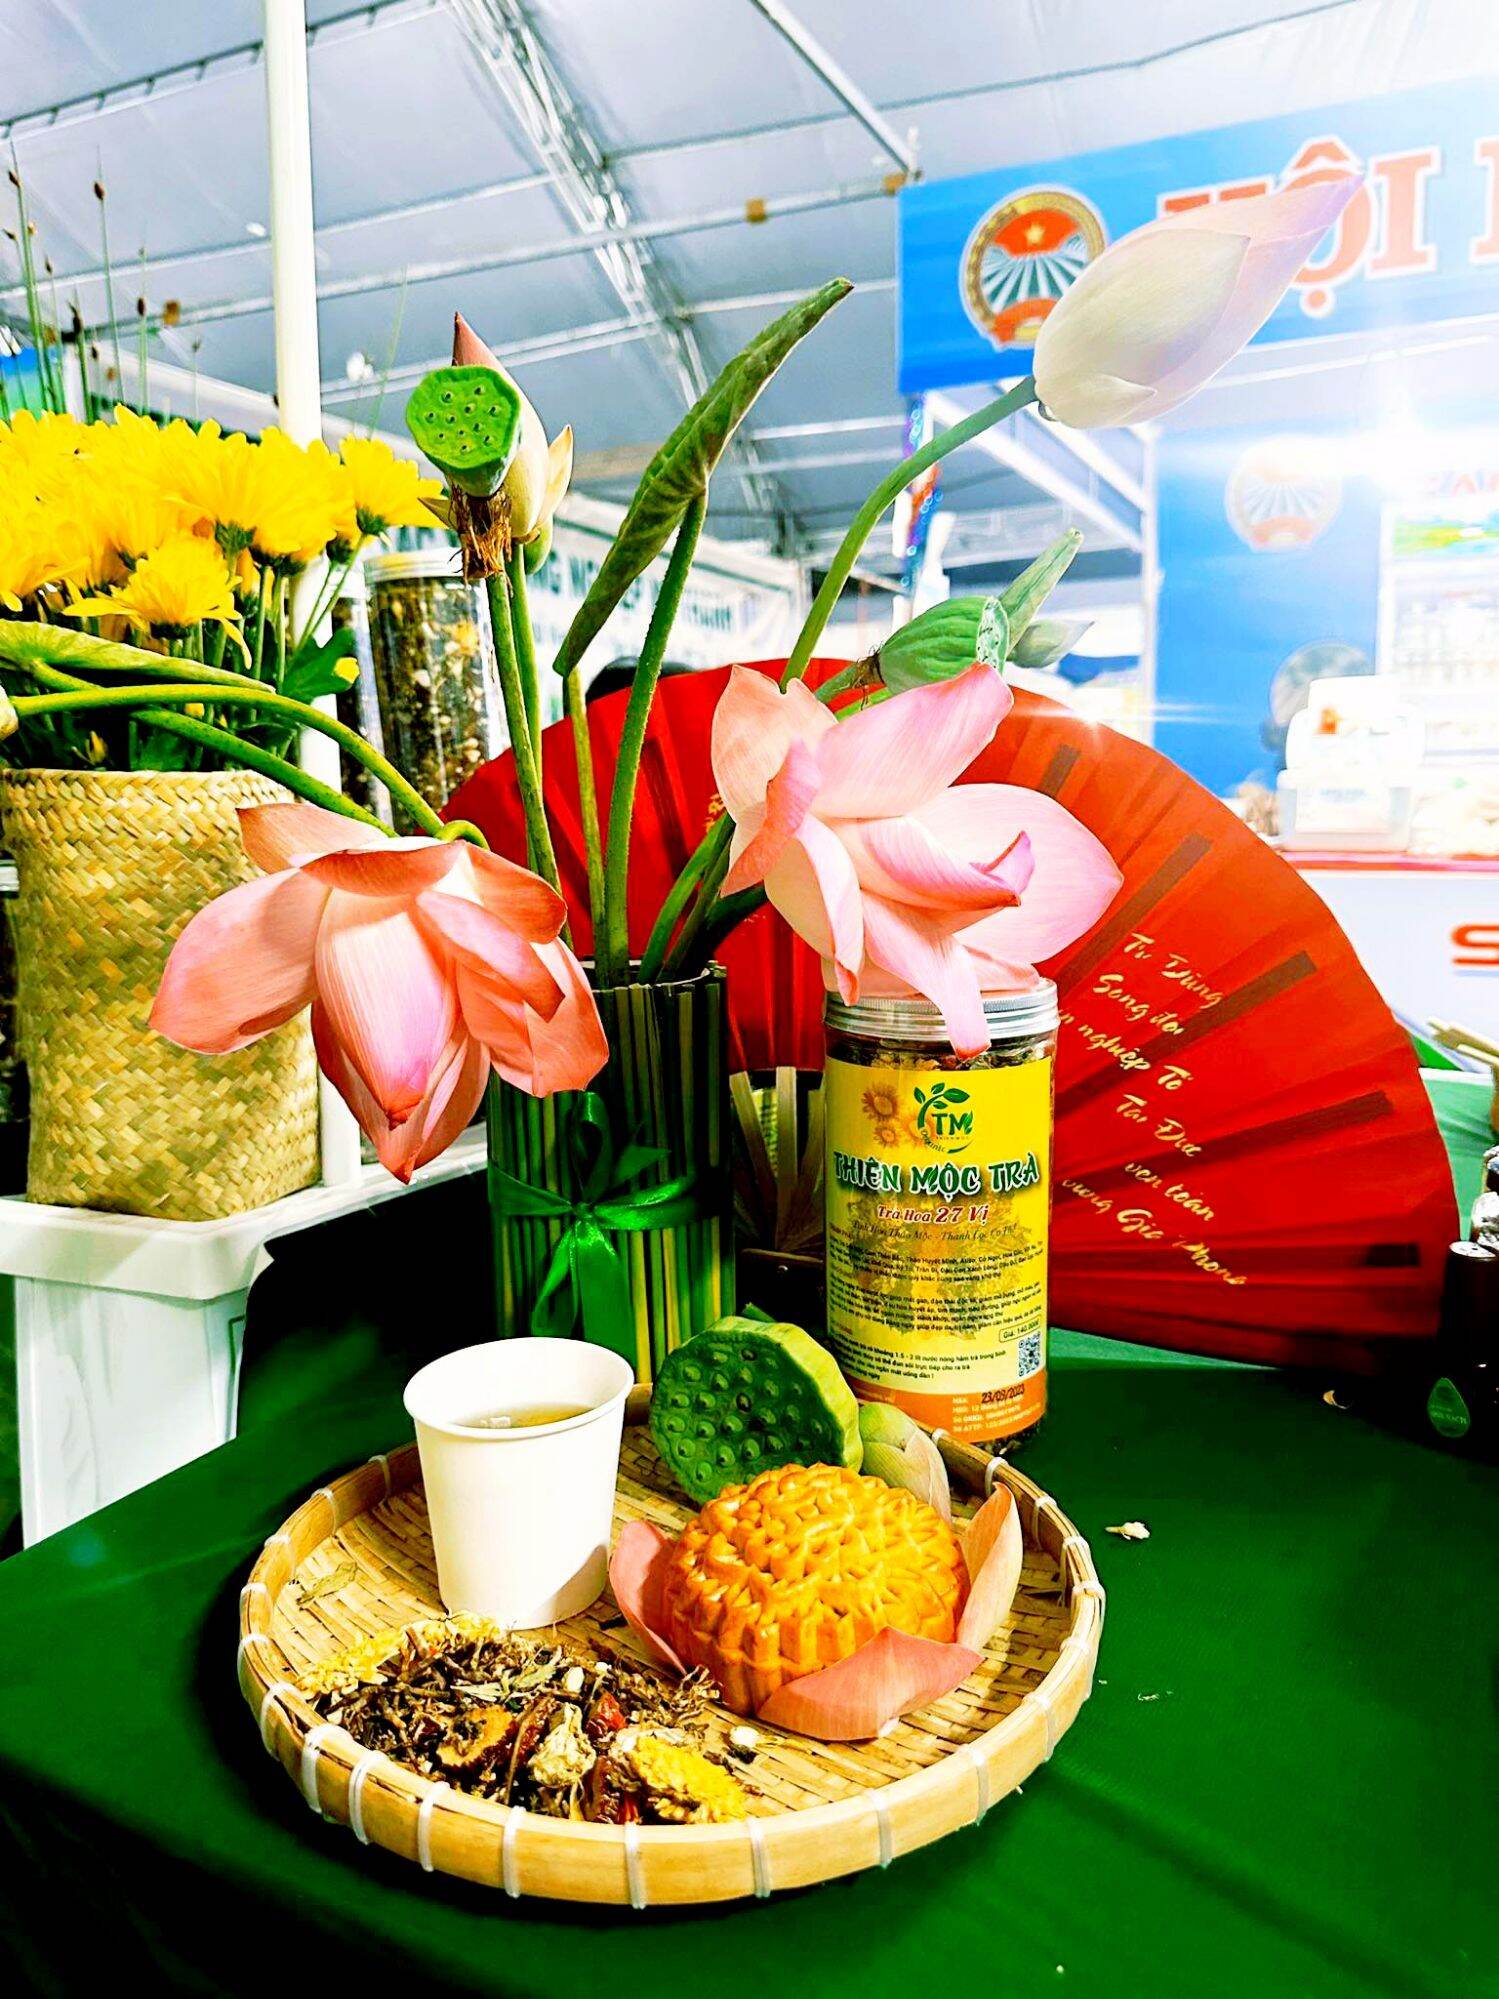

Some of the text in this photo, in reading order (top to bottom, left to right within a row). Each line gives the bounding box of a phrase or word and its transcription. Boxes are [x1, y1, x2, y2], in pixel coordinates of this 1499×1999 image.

[1162, 137, 1440, 318] ỘI
[931, 1110, 973, 1136] TM
[833, 1151, 1039, 1202] THIÊN MỘC TRÀ
[903, 1208, 932, 1223] Hoa
[935, 1207, 963, 1223] 27
[969, 1203, 989, 1226] Vị
